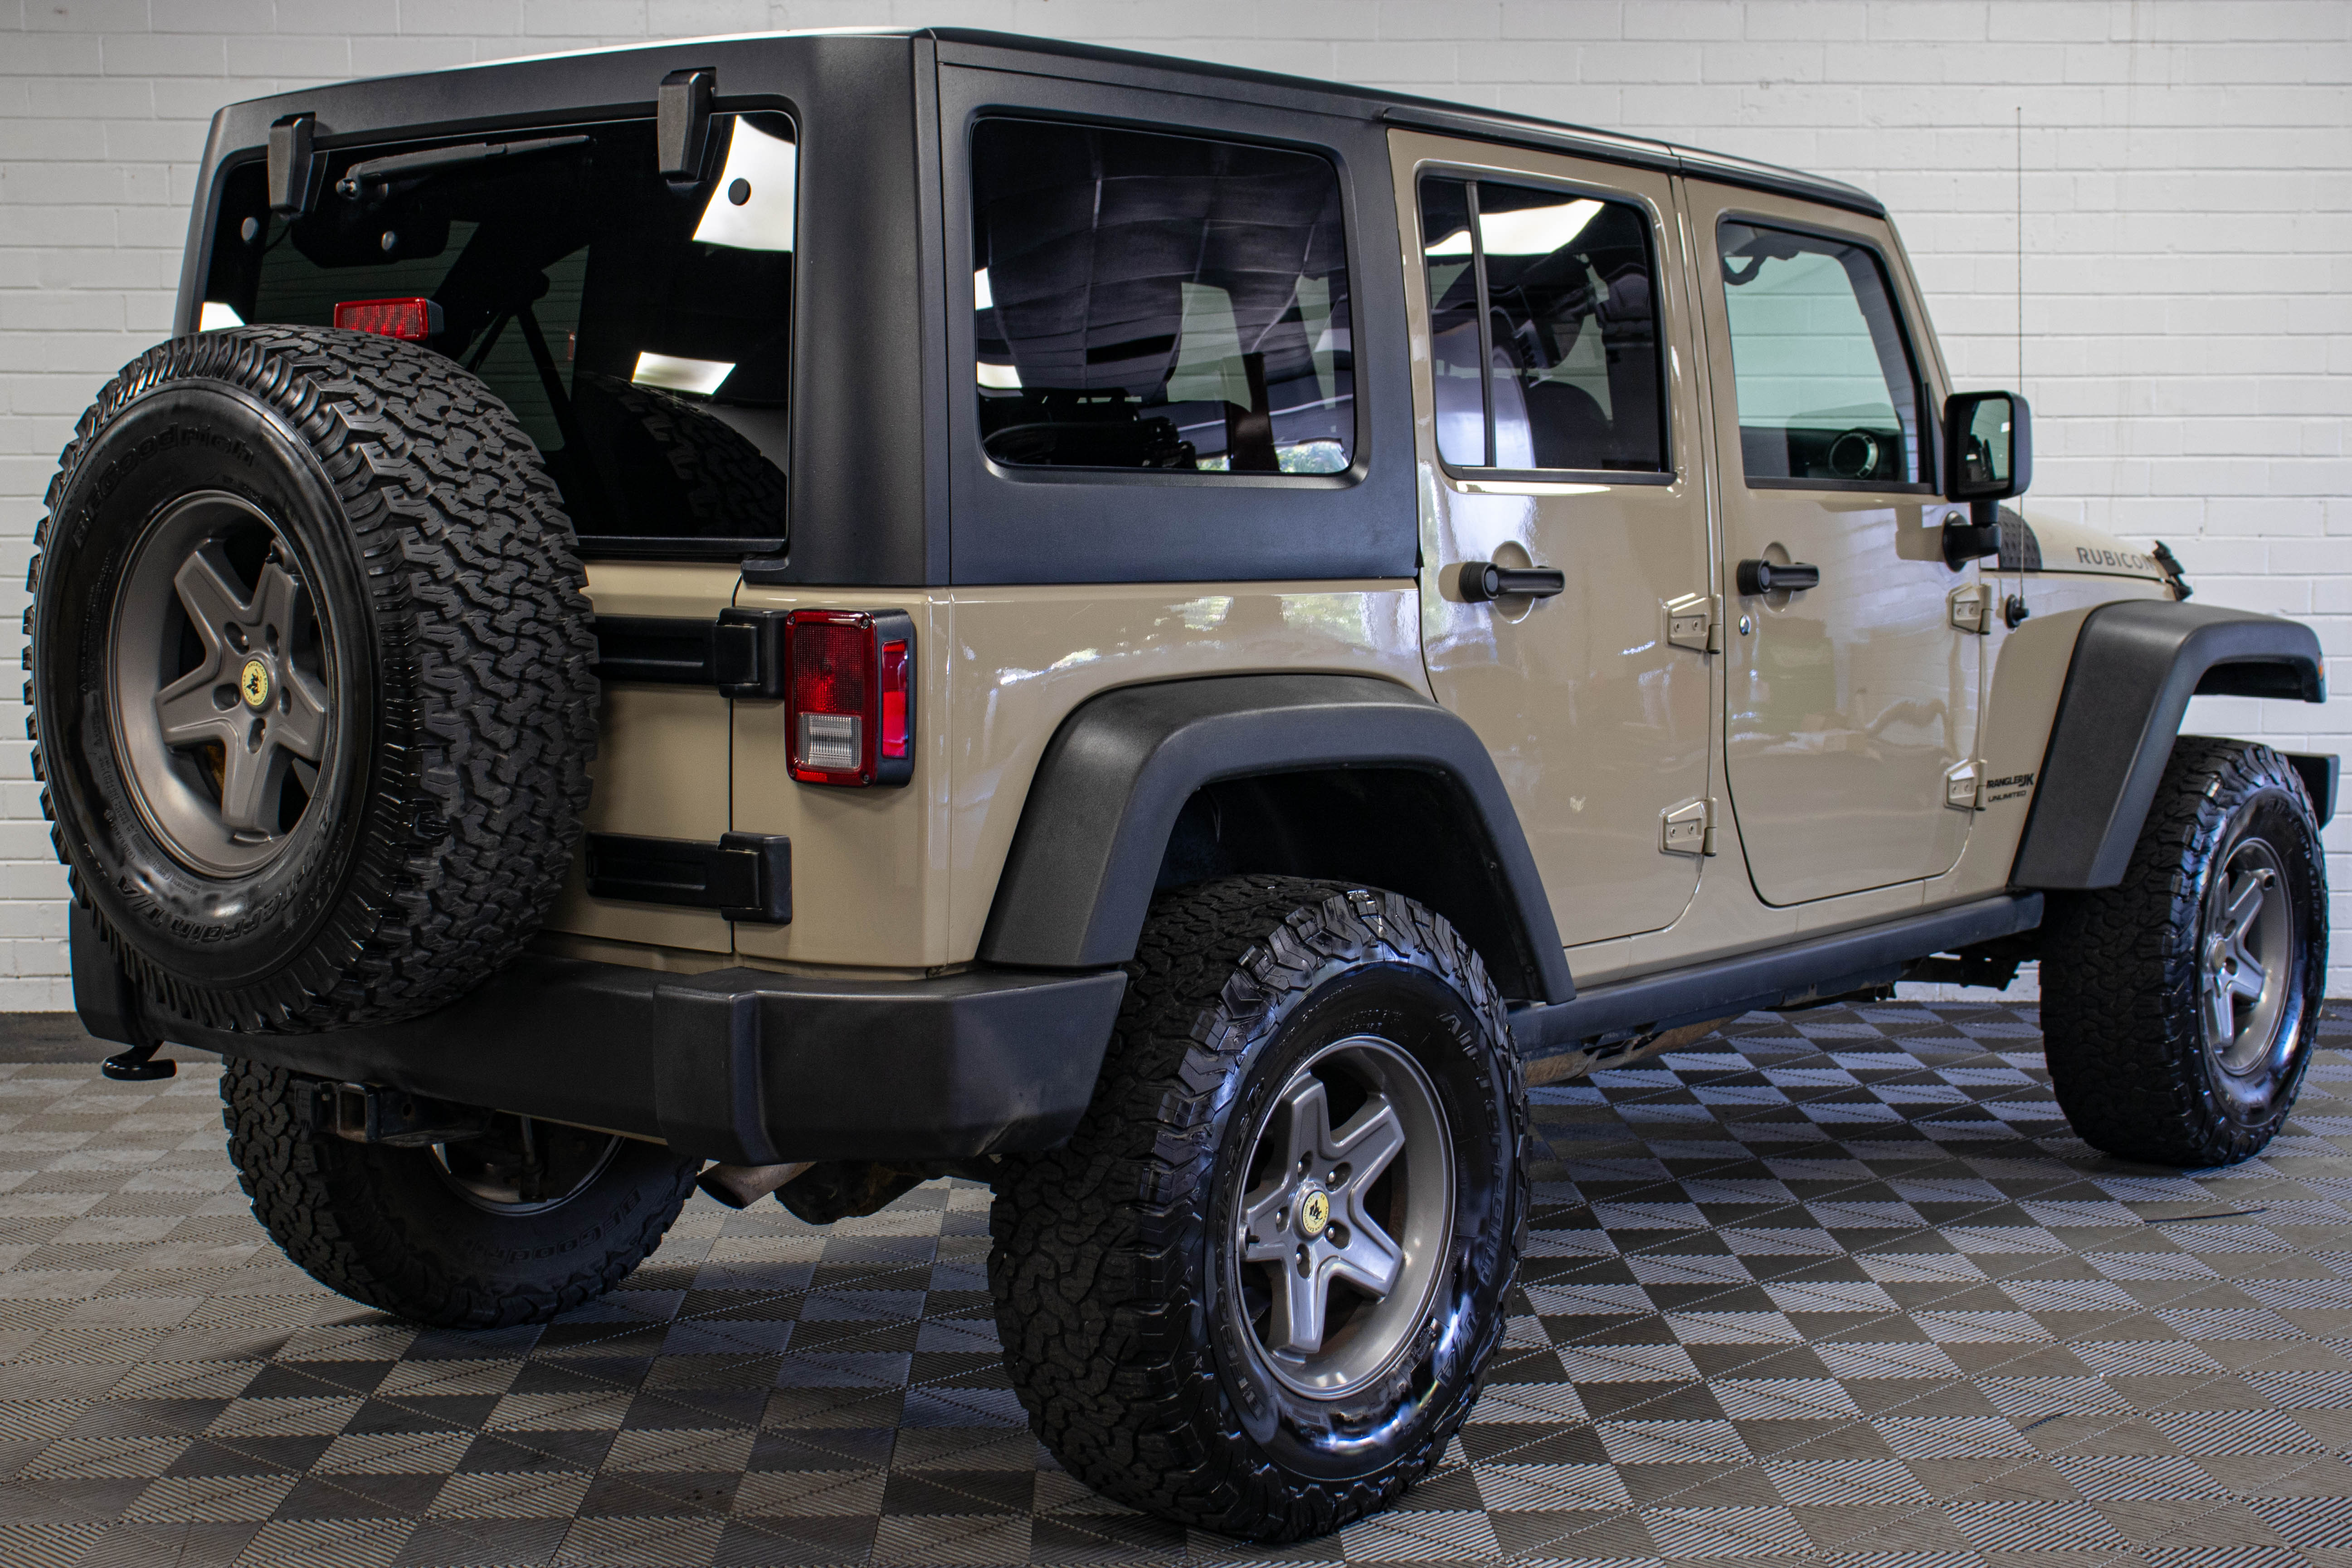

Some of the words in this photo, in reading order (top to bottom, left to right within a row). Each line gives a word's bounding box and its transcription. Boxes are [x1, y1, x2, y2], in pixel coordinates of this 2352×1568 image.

[72, 422, 254, 549] BFGoodrich
[1987, 776, 2022, 789] RANGLER
[1988, 791, 2026, 802] UNLIMITED
[1216, 1076, 1267, 1421] BFGoodrich
